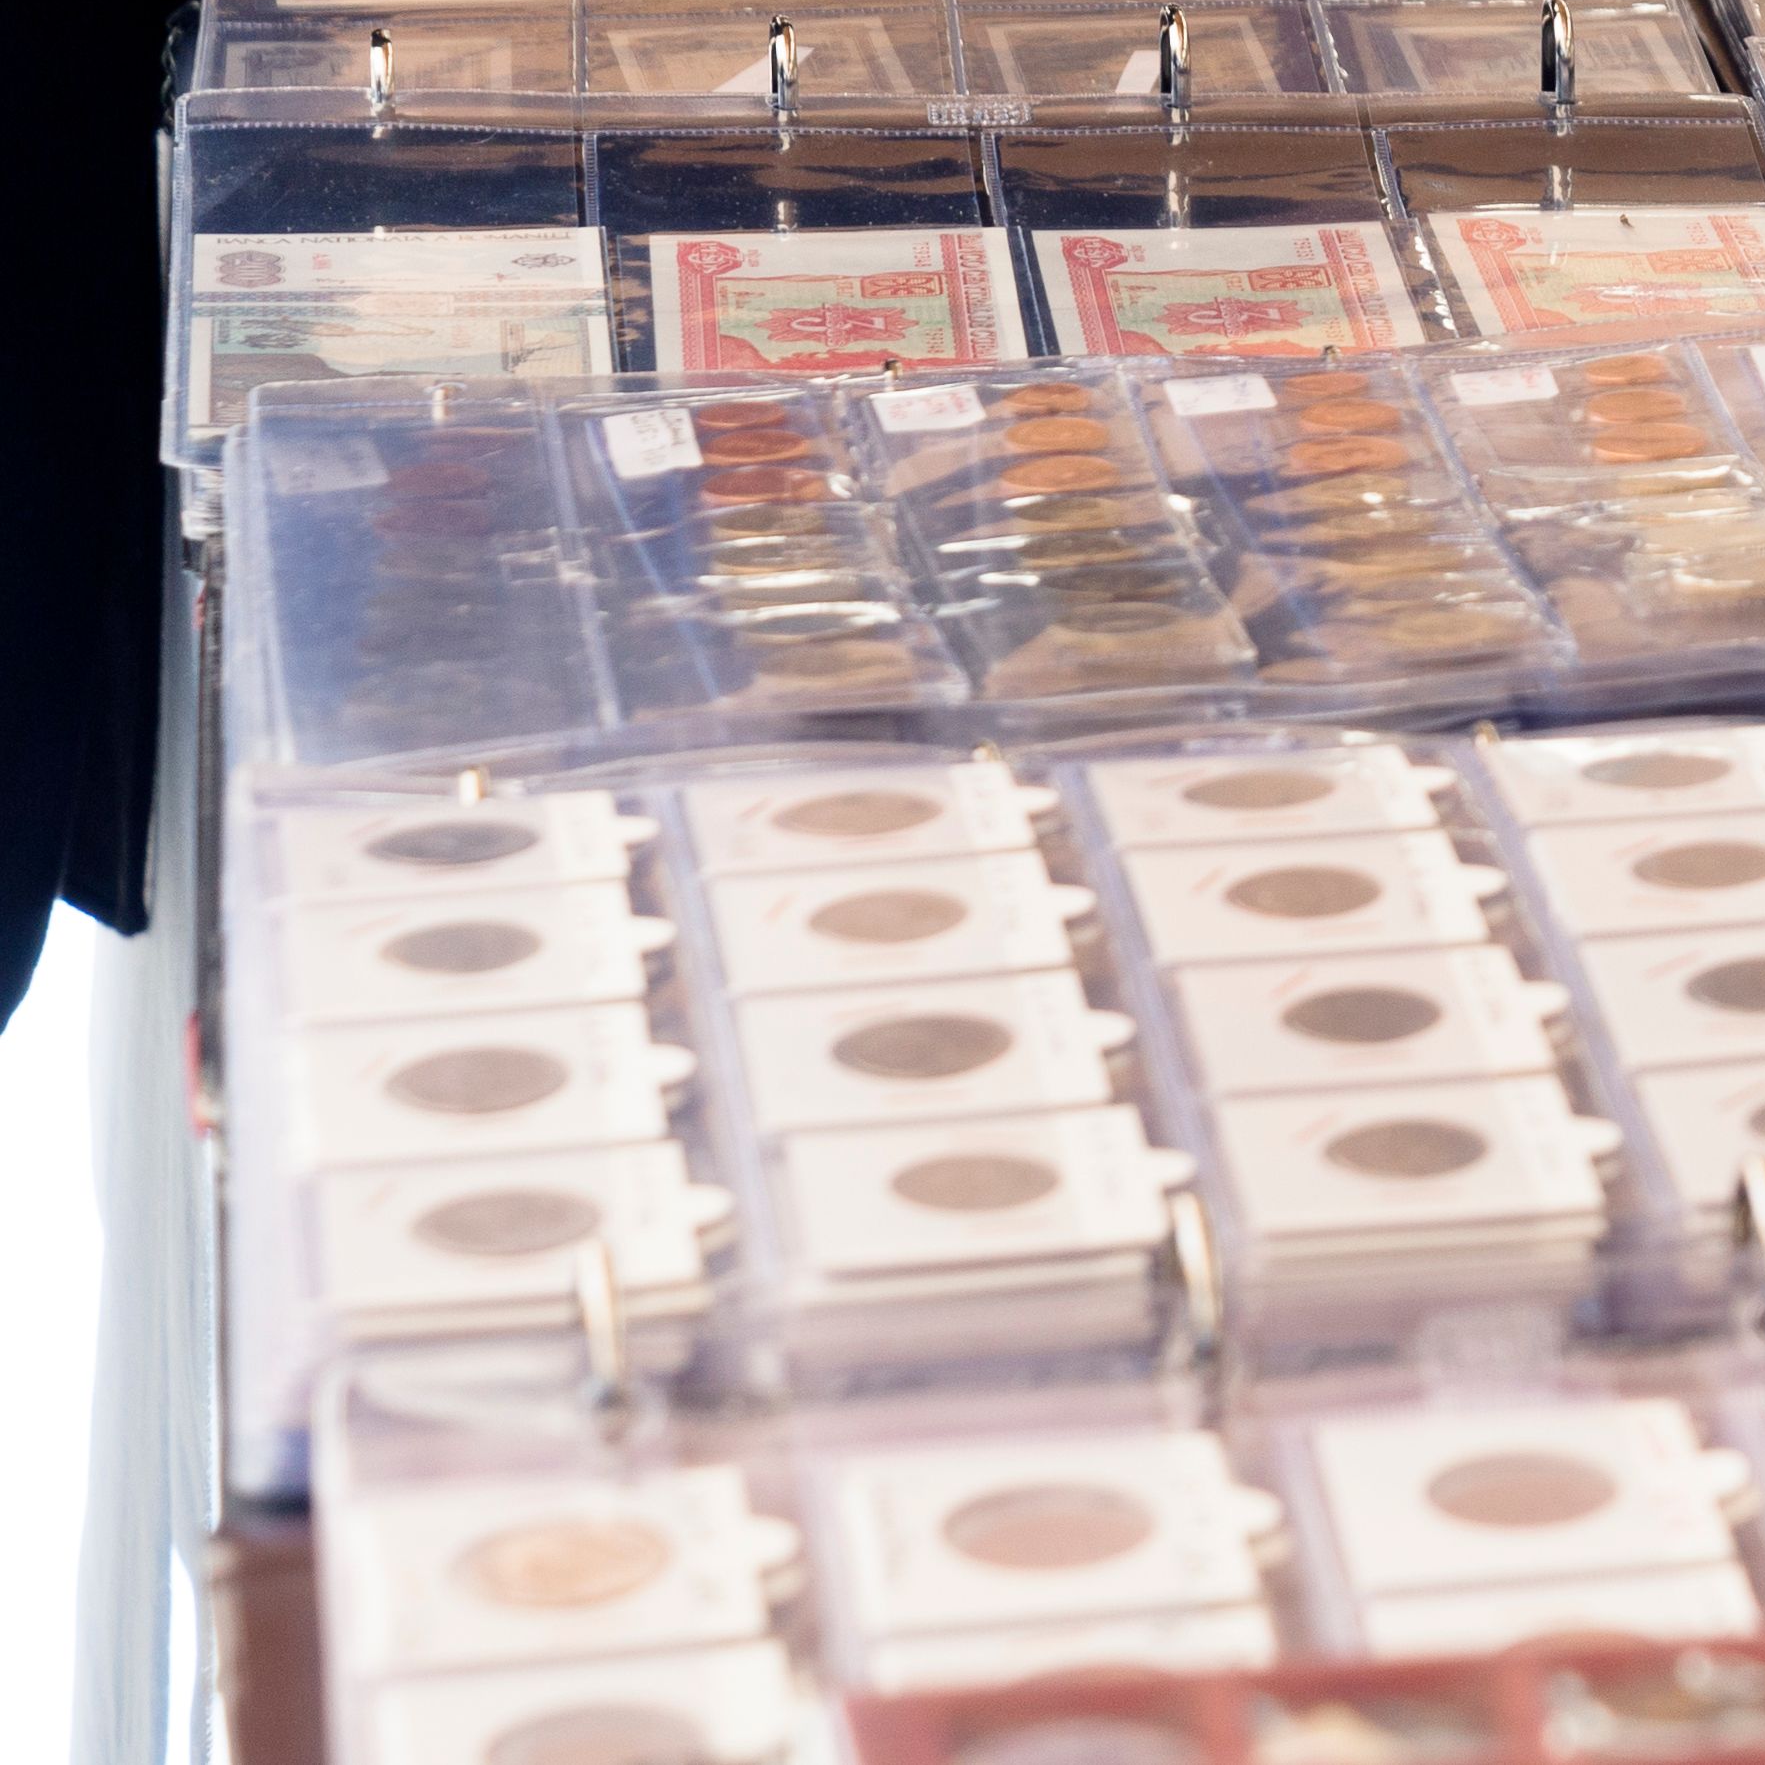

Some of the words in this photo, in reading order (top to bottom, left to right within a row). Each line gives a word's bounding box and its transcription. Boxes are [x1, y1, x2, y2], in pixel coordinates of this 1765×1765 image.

[955, 234, 989, 268] BANCO
[1333, 228, 1370, 260] BANCO
[960, 269, 996, 313] CENTRAL
[1343, 261, 1384, 303] CENTRAL
[966, 313, 998, 328] DE
[1357, 303, 1389, 317] DE
[968, 328, 1003, 358] CUBA
[1362, 317, 1398, 345] CUBA
